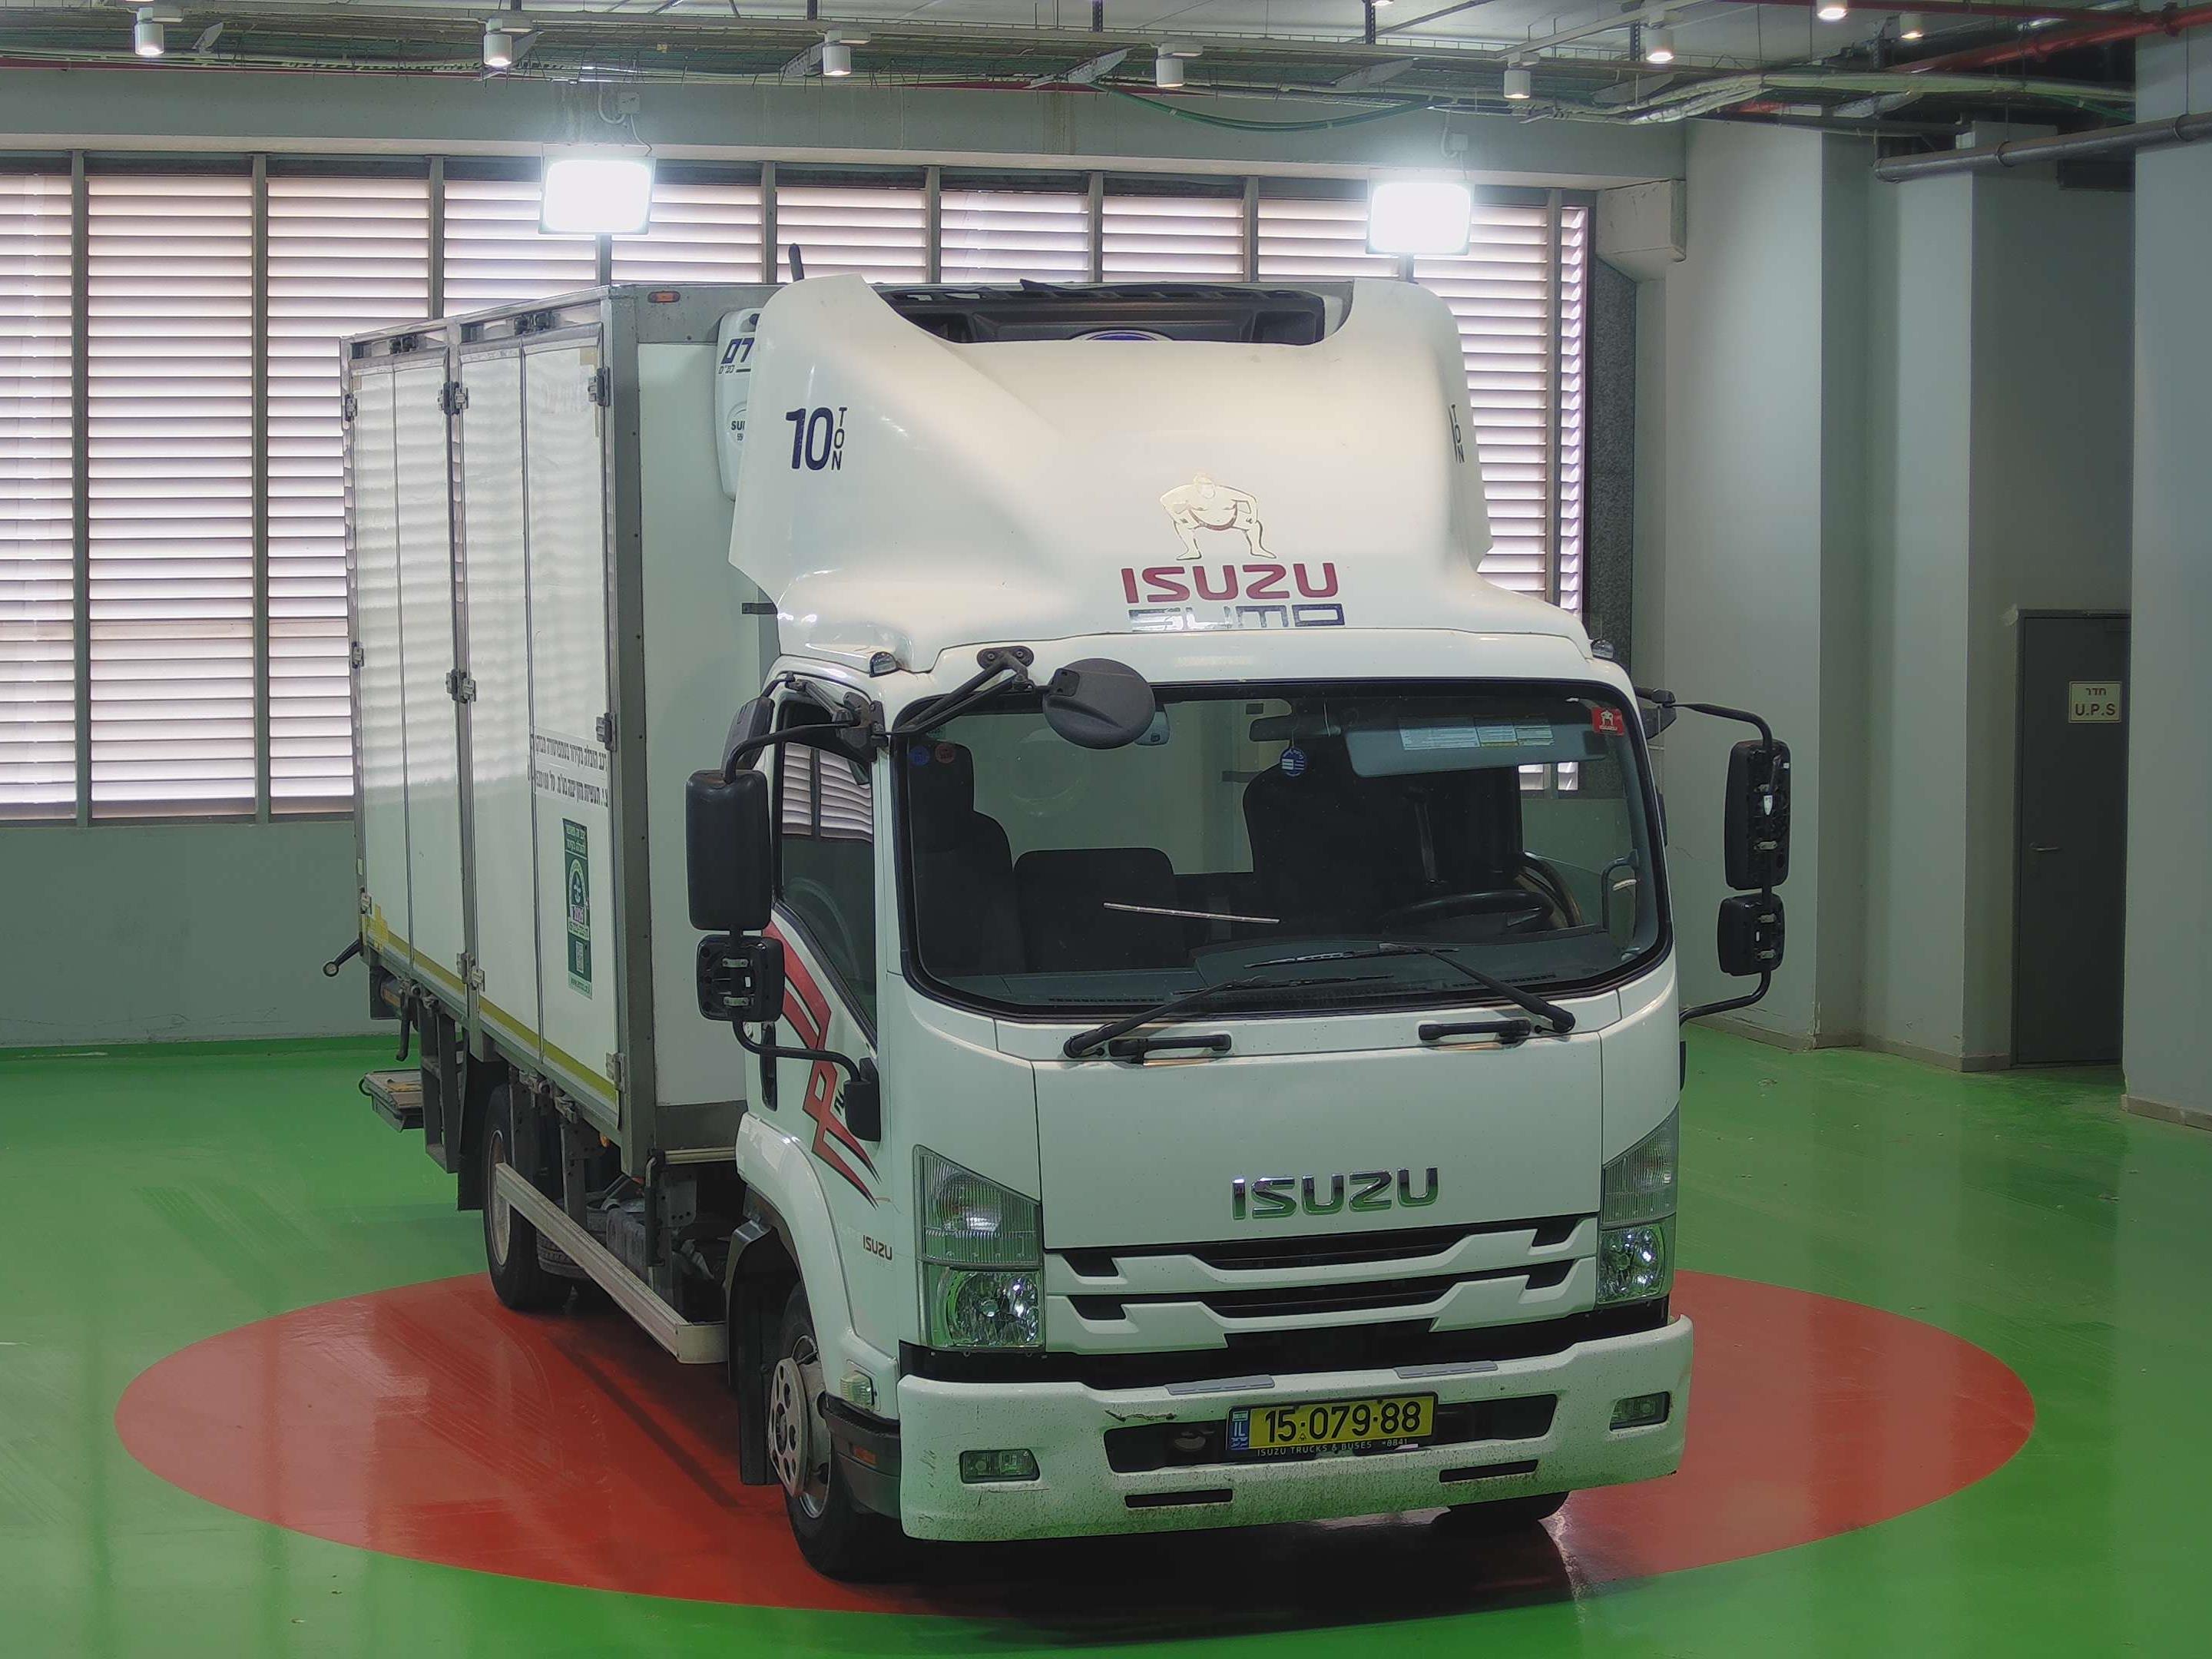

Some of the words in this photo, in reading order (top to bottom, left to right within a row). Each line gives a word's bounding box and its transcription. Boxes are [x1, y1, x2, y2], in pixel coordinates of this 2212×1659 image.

[786, 407, 833, 470] 10
[831, 406, 847, 470] TON
[1121, 562, 1339, 604] ISUZU
[2085, 687, 2107, 696] חדר
[2075, 704, 2116, 716] U.P.S
[1232, 1167, 1439, 1220] ISUZU
[863, 1234, 892, 1261] ISUZU
[1233, 1421, 1246, 1437] IL
[1257, 1448, 1287, 1457] ISUZU
[1291, 1445, 1328, 1455] TRUCKS
